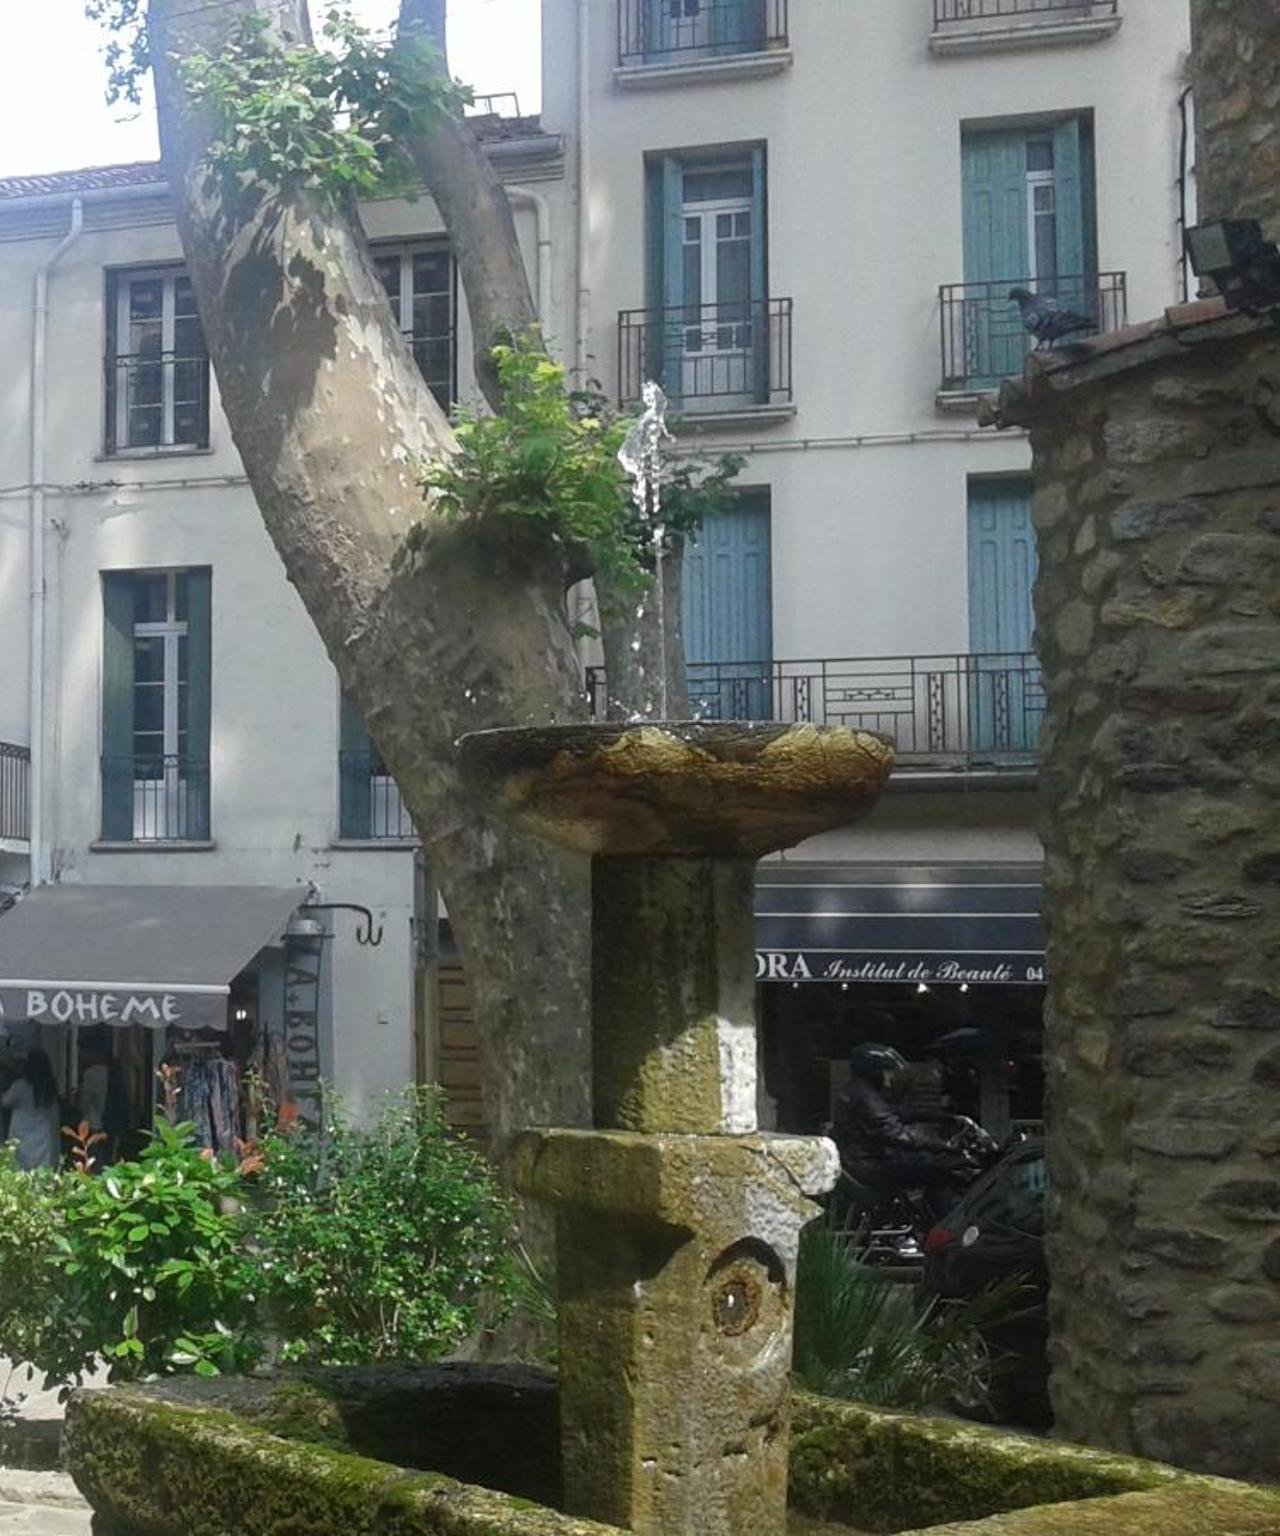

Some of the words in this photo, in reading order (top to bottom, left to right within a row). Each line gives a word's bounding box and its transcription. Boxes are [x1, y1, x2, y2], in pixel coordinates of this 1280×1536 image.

[823, 959, 907, 979] Institut
[907, 961, 934, 979] de
[936, 960, 1013, 981] Beauté
[26, 990, 182, 1022] BOHEME
